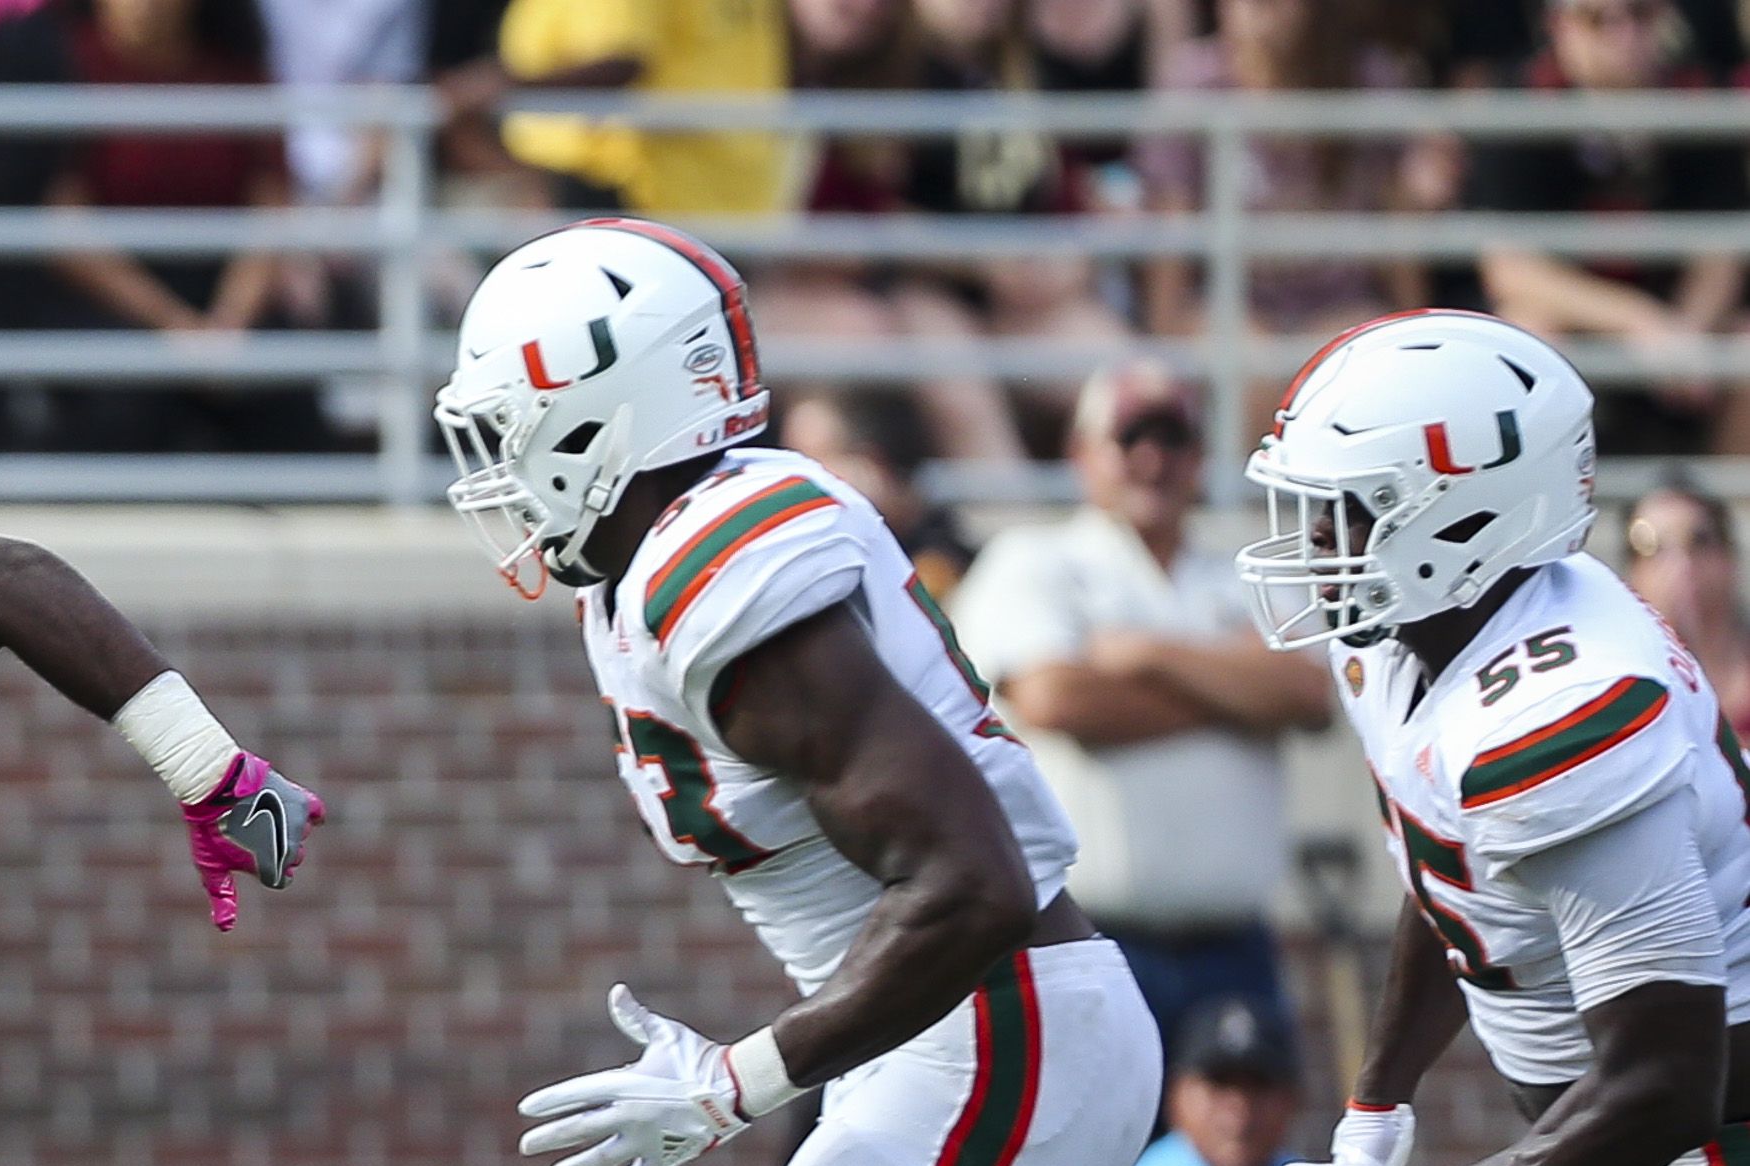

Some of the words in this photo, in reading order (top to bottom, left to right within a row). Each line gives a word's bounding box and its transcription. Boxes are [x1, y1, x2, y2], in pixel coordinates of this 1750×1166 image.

[522, 317, 617, 390] U
[1423, 410, 1520, 476] U
[1475, 625, 1579, 708] 55
[602, 696, 776, 876] 3
